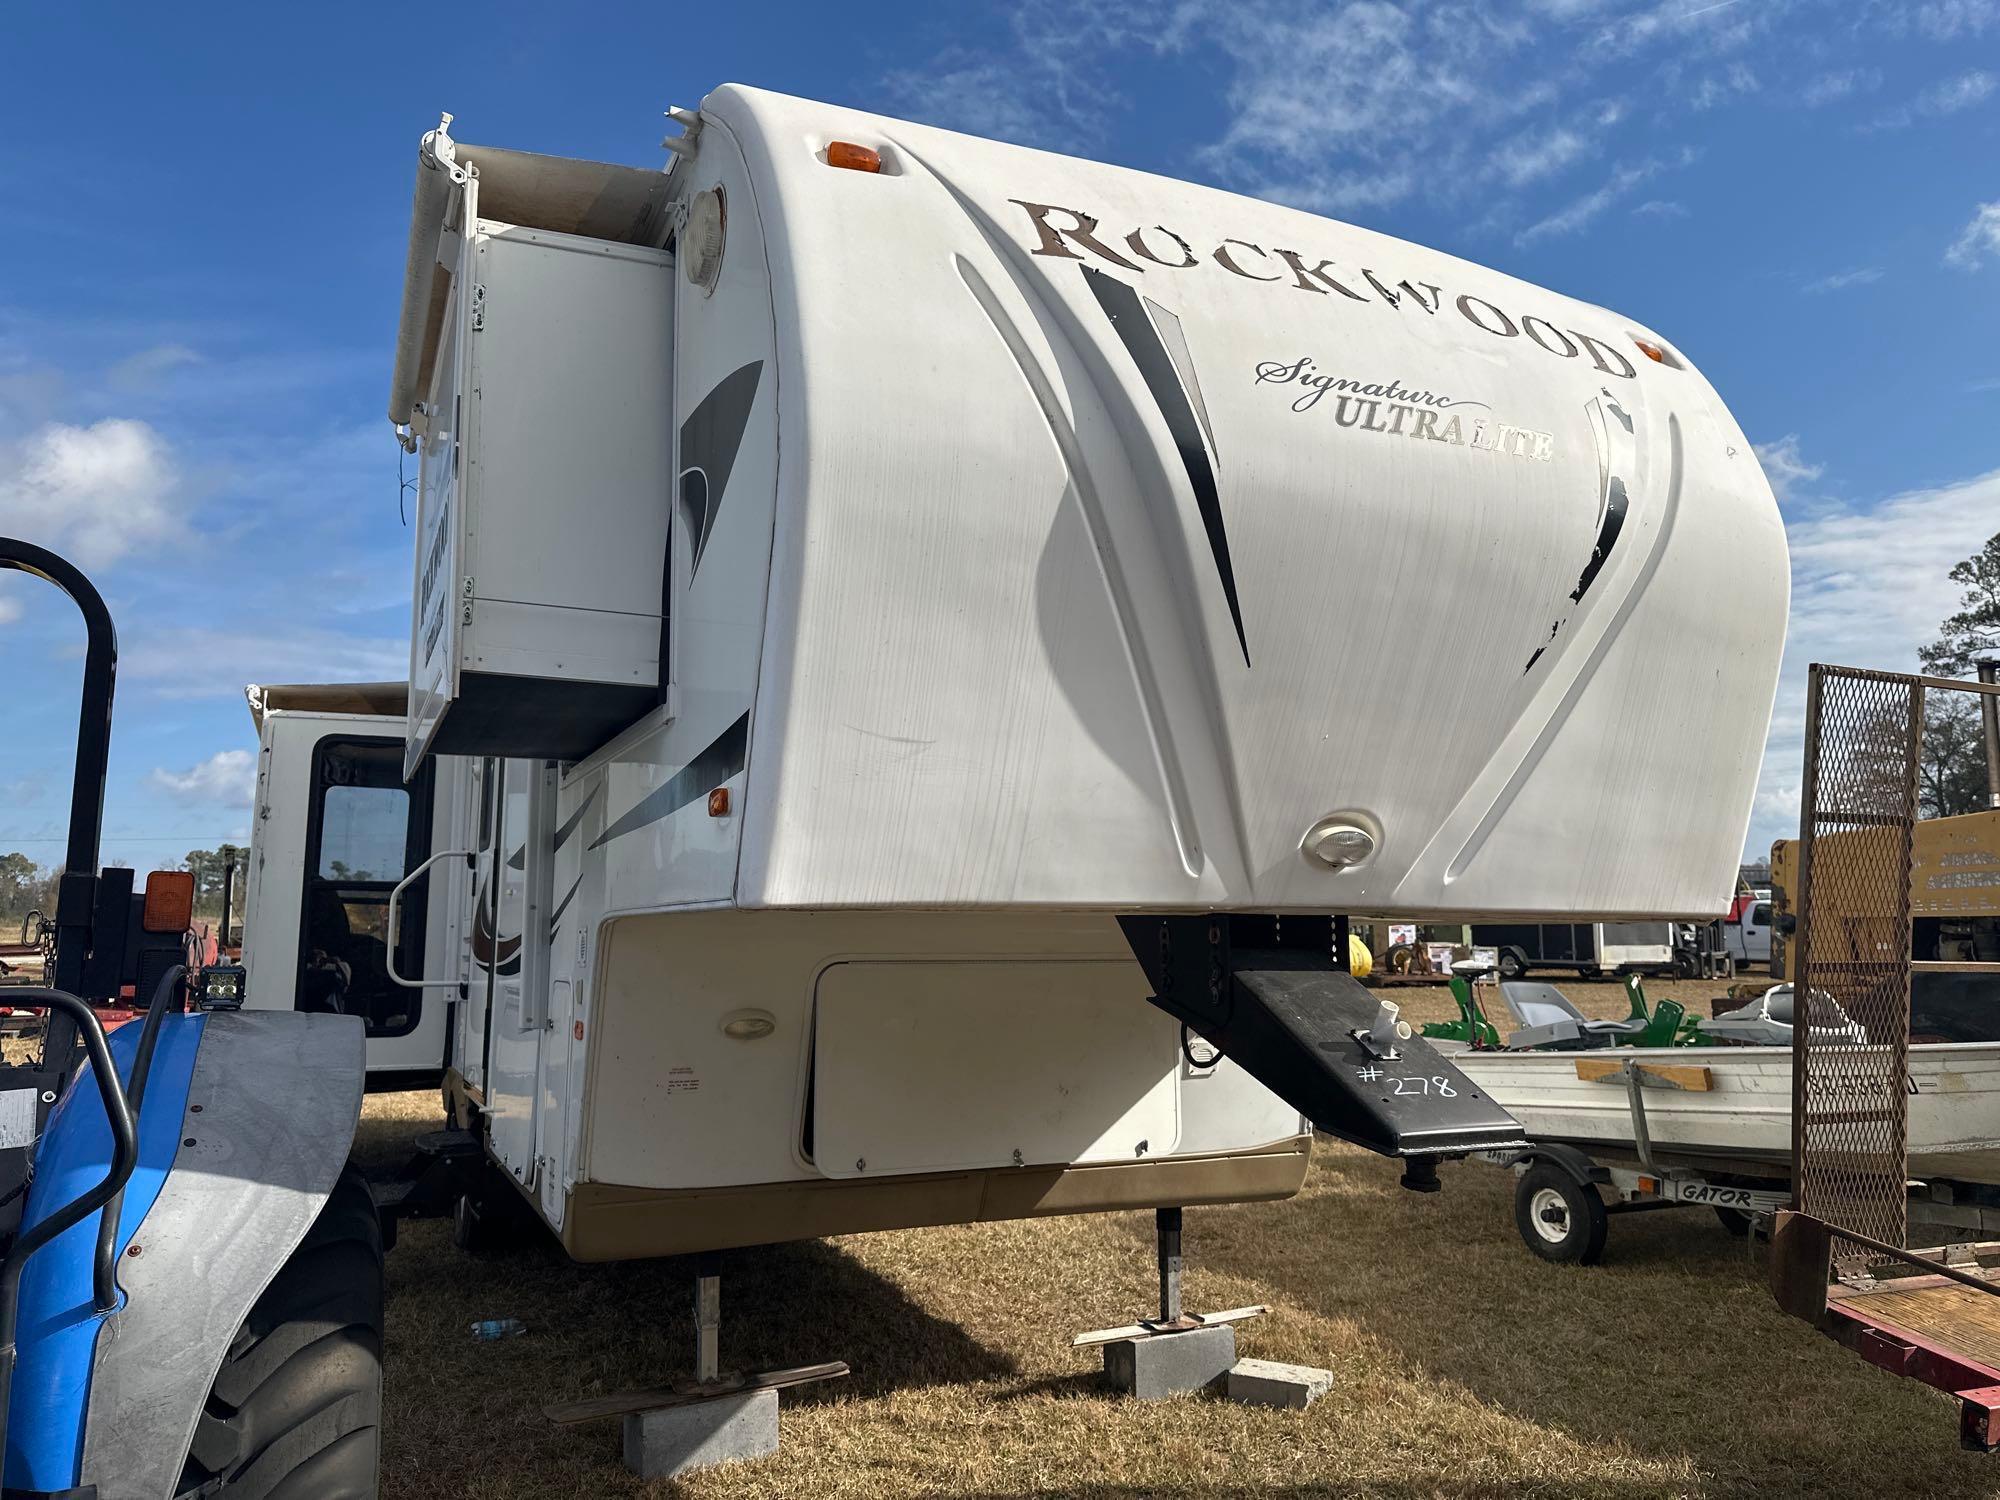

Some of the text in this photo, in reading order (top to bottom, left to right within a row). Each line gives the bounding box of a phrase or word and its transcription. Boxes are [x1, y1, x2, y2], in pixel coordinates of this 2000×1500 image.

[1007, 198, 1637, 379] ROCKWOOD
[1254, 356, 1492, 413] Signature
[1682, 1184, 1751, 1207] GATOR
